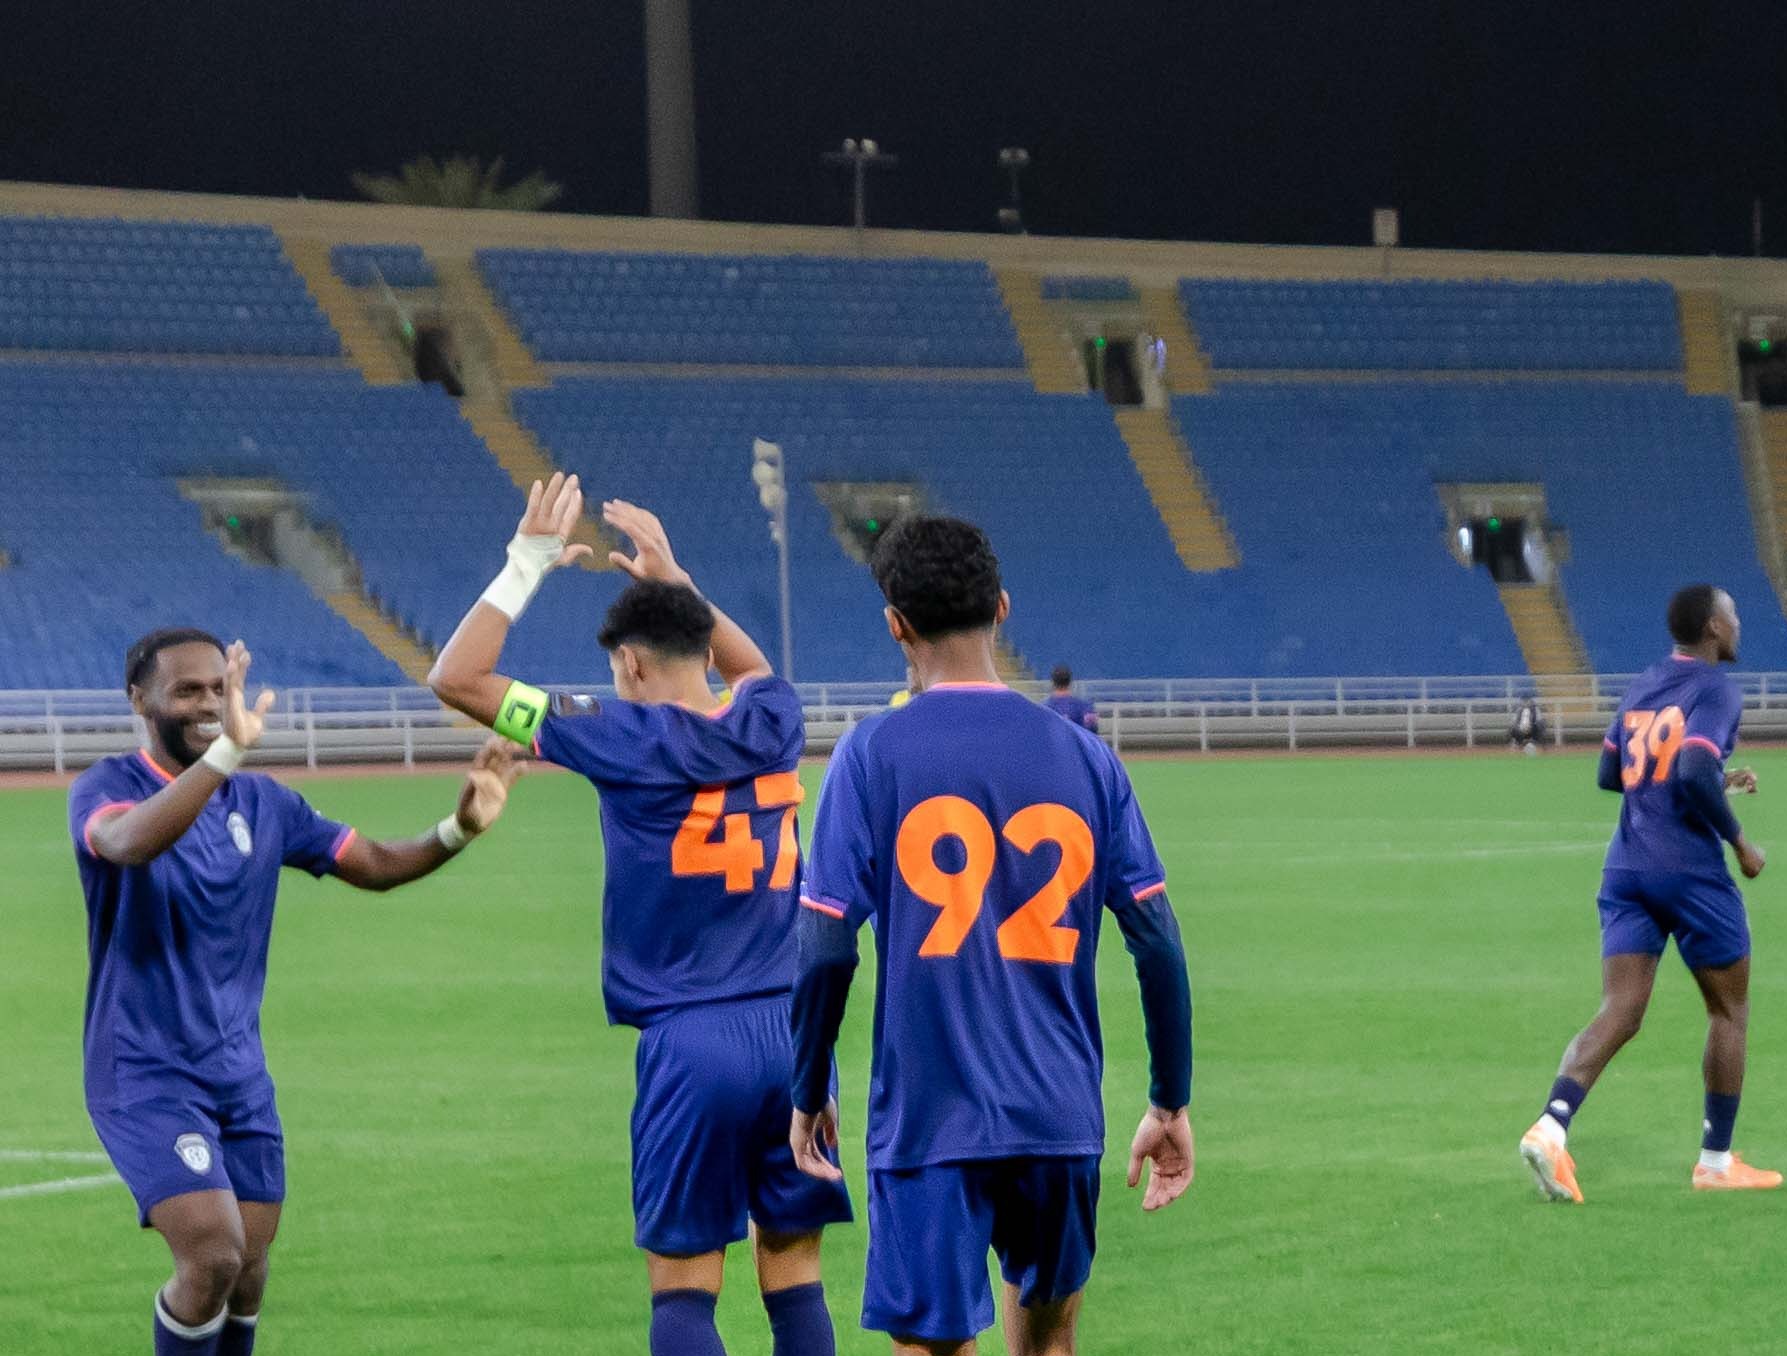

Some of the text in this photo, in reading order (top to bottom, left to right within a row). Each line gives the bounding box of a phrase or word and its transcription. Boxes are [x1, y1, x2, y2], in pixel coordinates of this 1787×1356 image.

[1621, 705, 1686, 790] 39
[671, 770, 805, 893] 47
[896, 796, 1096, 963] 92
